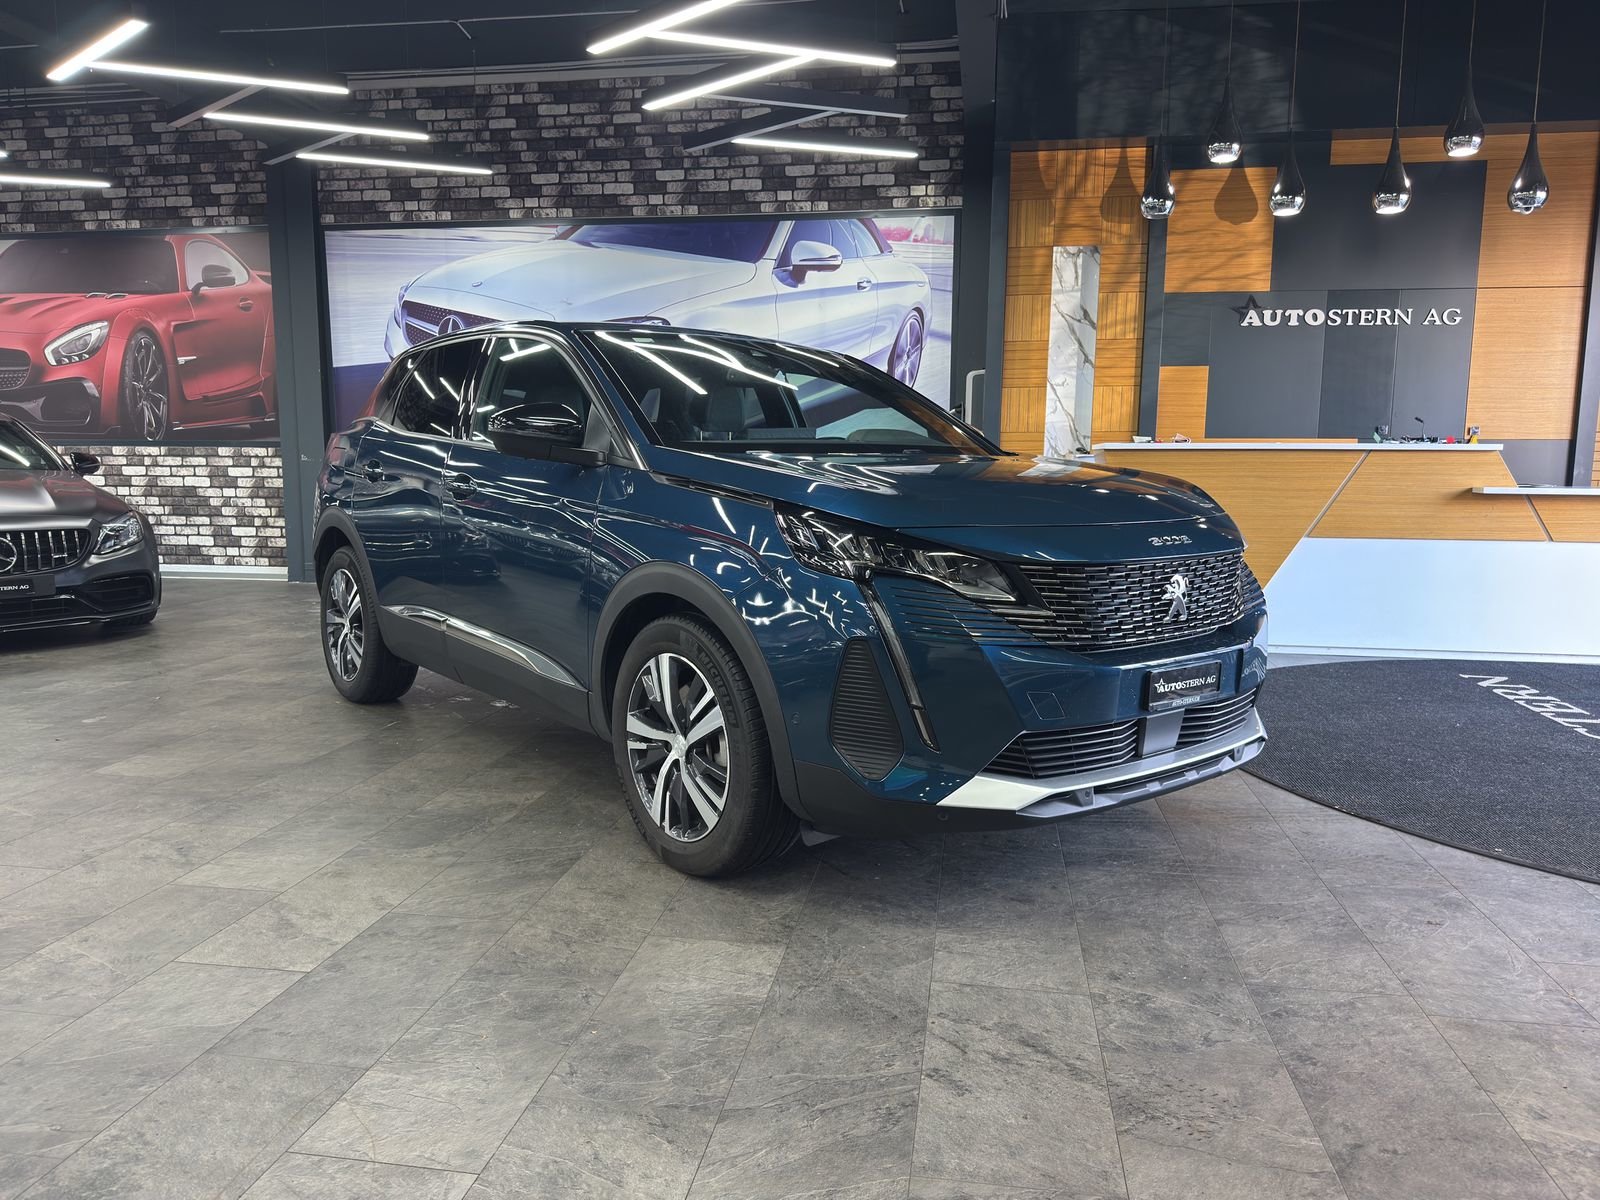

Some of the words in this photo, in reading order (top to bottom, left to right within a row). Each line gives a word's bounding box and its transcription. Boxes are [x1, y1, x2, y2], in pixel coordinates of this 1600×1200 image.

[1240, 308, 1413, 327] AUTOSTERN
[1422, 308, 1462, 326] AG
[1157, 677, 1206, 693] AUTOSTERN
[1206, 675, 1217, 685] AG
